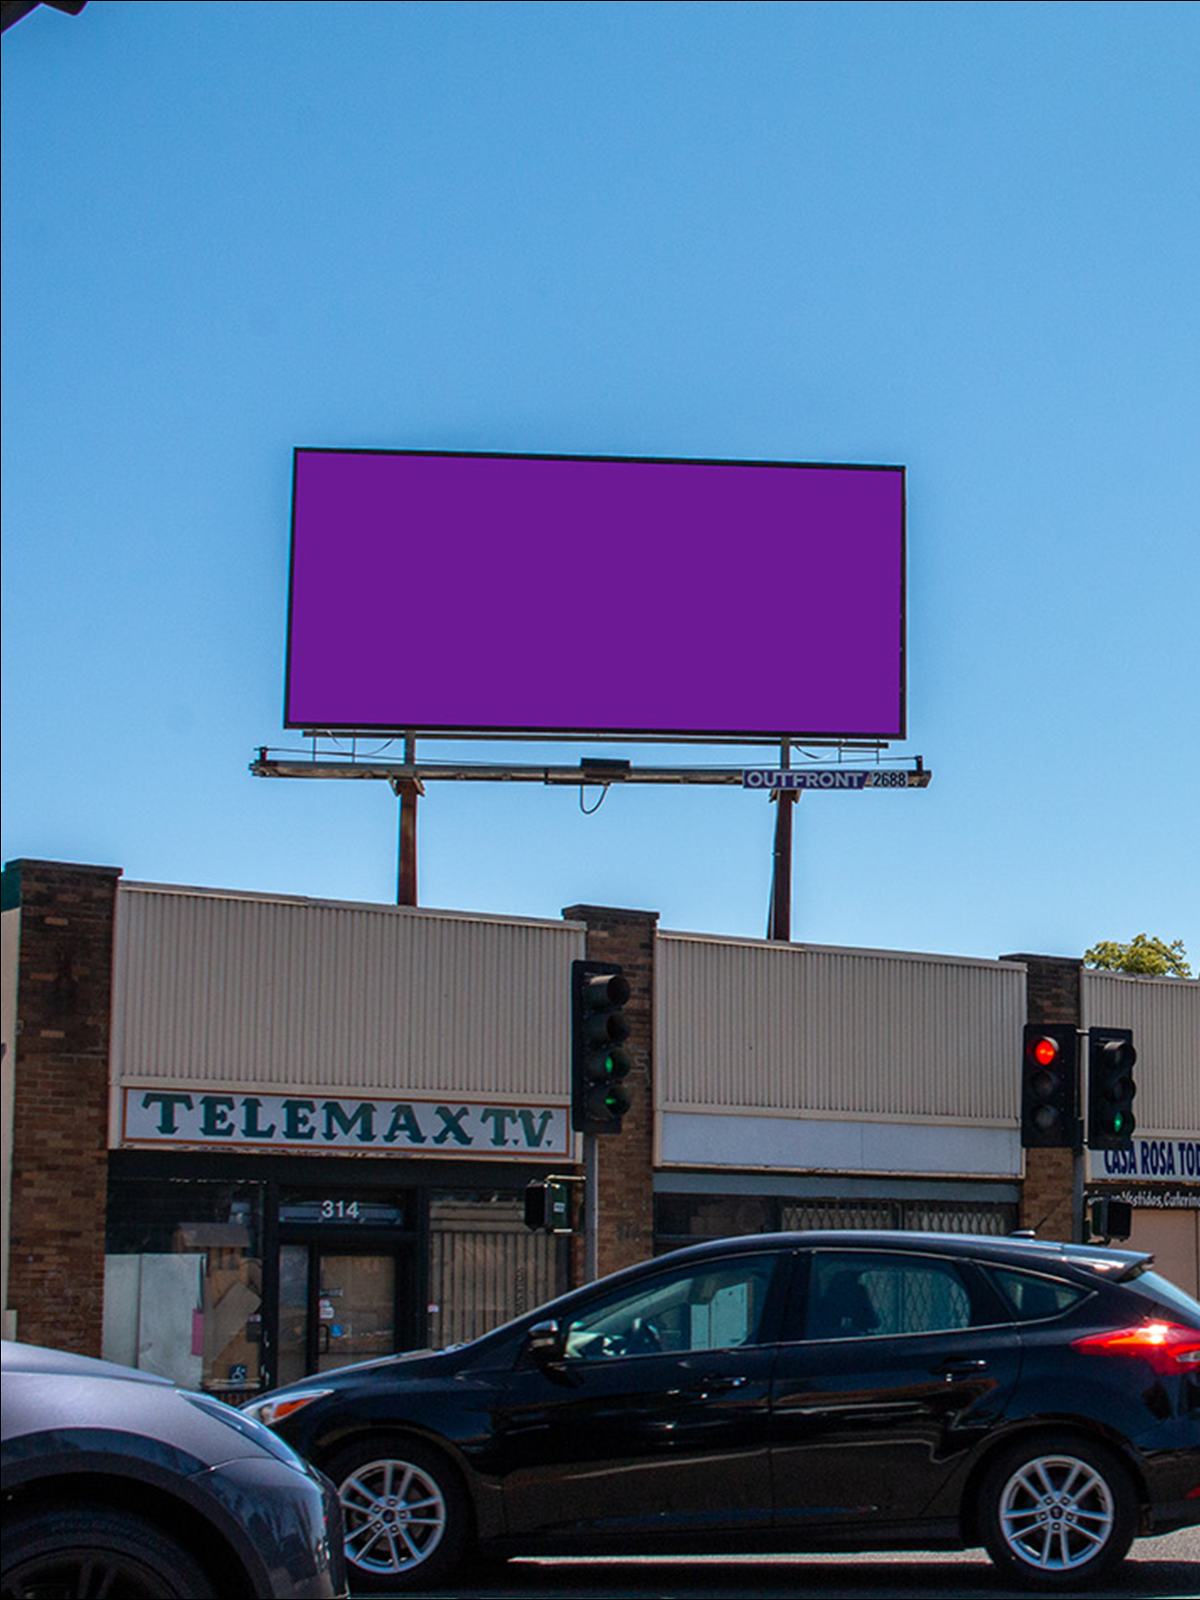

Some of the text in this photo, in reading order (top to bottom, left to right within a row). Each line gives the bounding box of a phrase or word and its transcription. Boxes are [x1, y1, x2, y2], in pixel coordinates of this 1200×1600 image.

[747, 771, 907, 788] OUTFRONT 2688
[142, 1092, 555, 1148] TELEMAX T.V.
[1104, 1141, 1137, 1175] CASA
[1141, 1141, 1175, 1176] ROSA
[322, 1201, 360, 1219] 314
